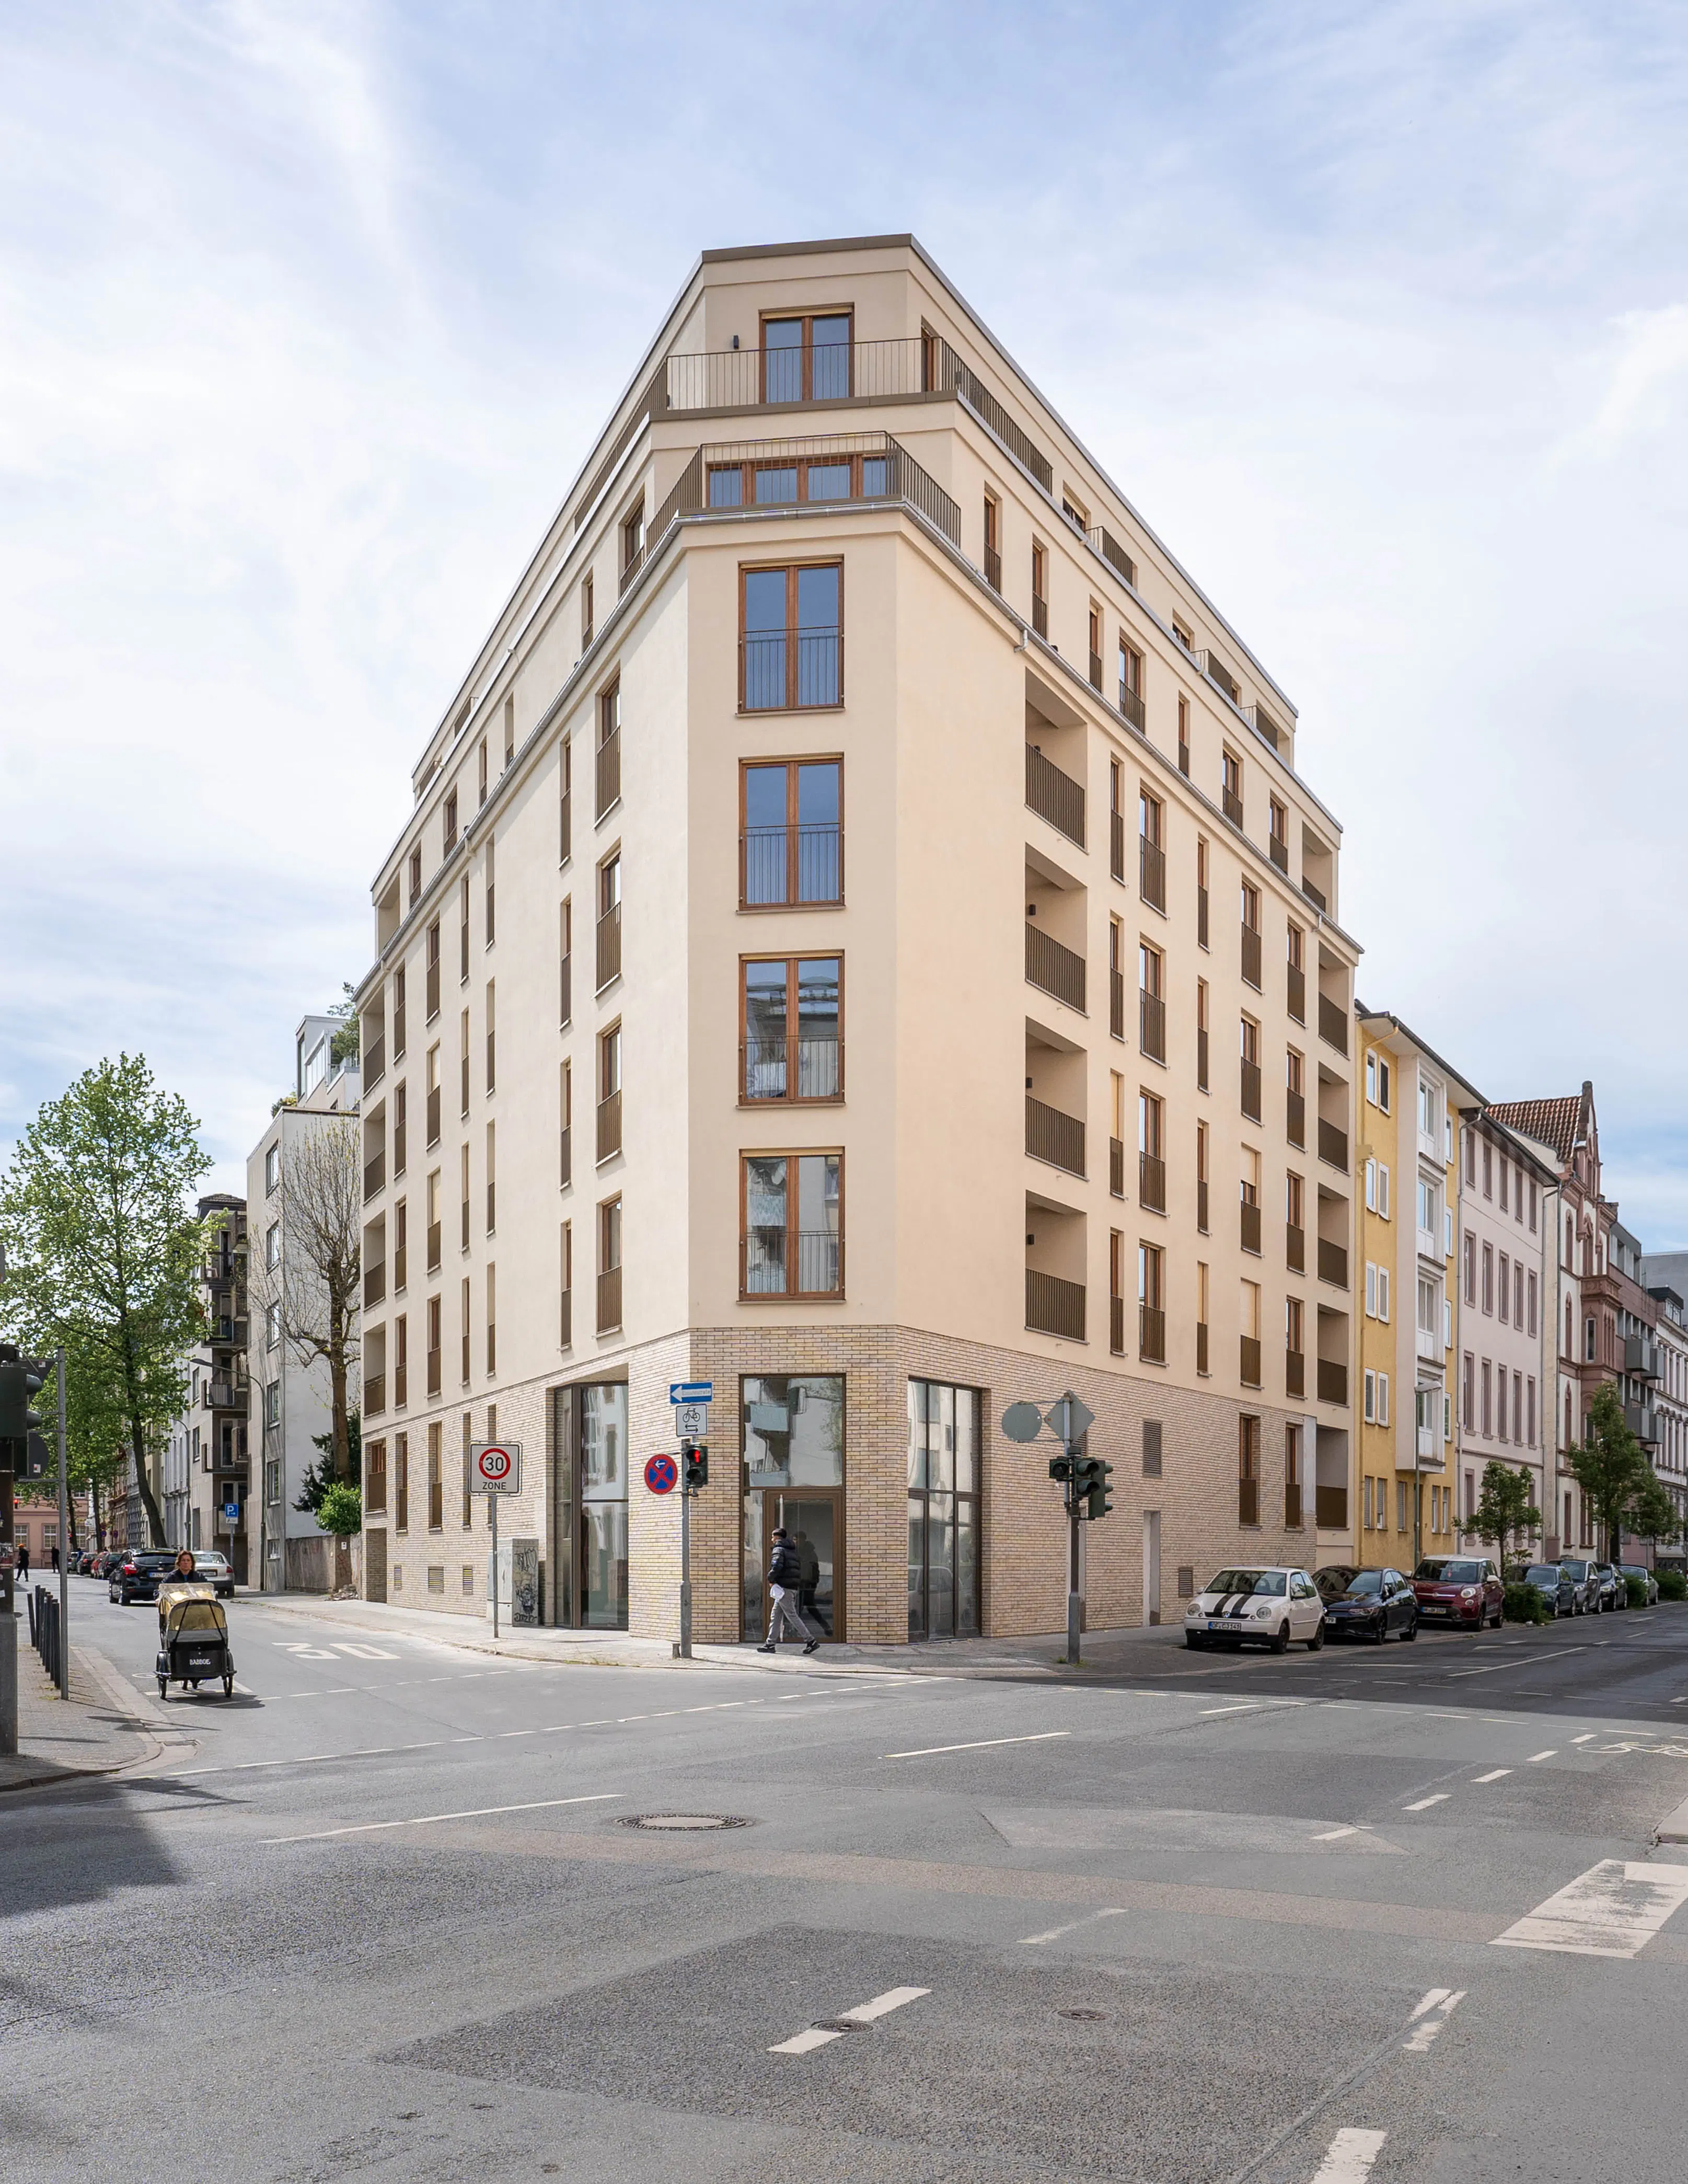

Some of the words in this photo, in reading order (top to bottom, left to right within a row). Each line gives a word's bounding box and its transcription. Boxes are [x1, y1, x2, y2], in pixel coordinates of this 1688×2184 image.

[485, 1457, 503, 1471] 30
[227, 1505, 234, 1515] P
[271, 1642, 401, 1659] 30
